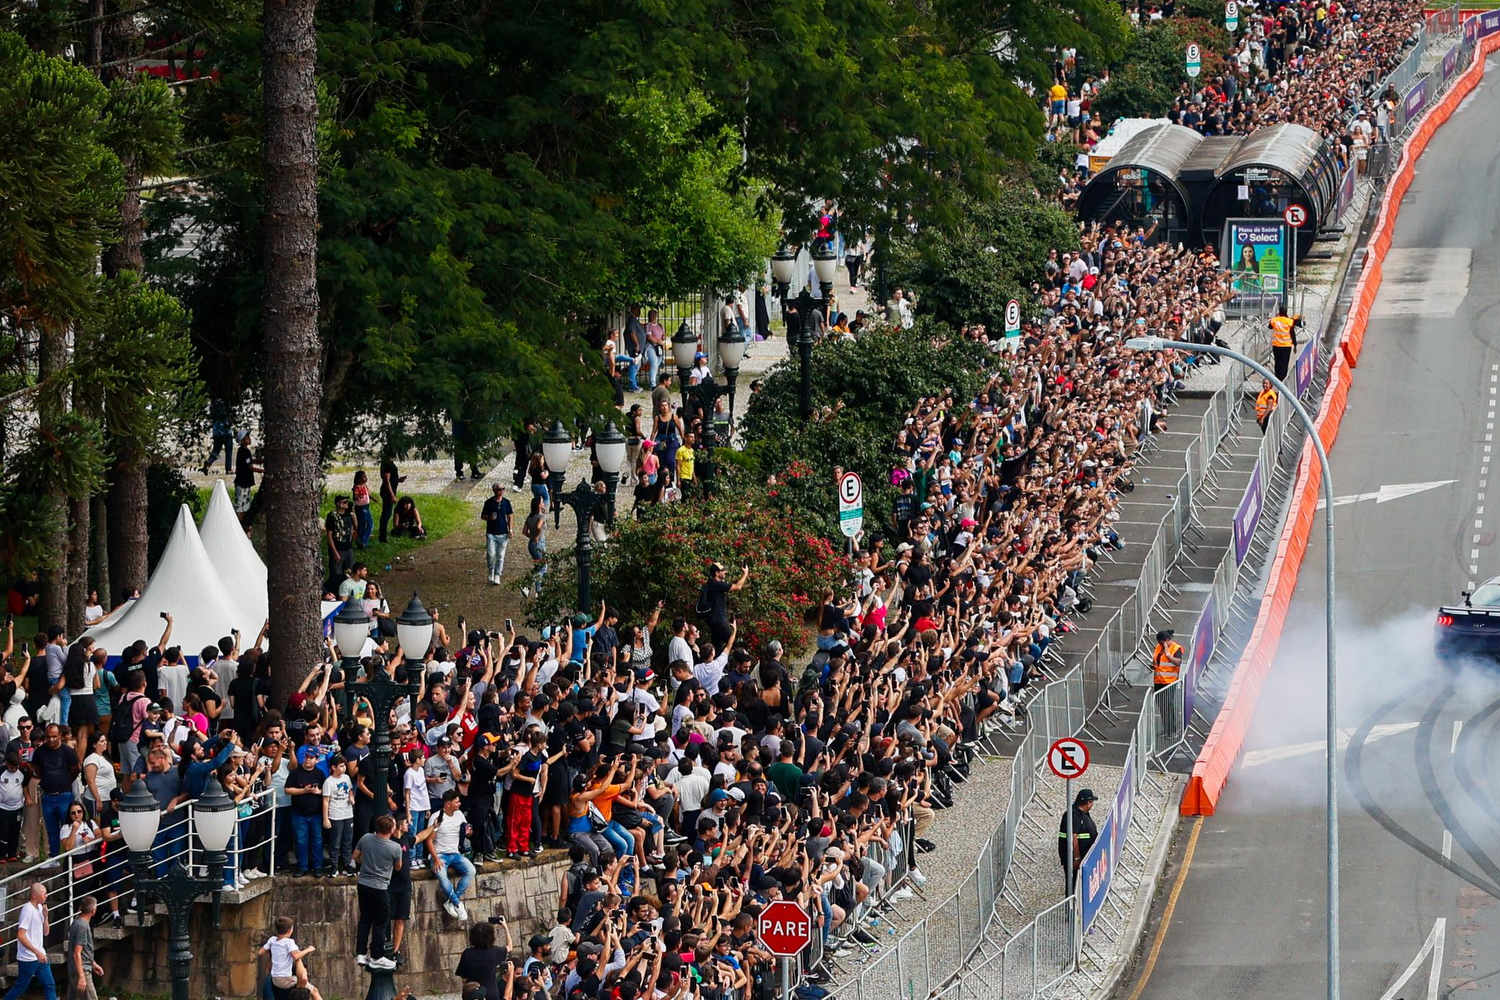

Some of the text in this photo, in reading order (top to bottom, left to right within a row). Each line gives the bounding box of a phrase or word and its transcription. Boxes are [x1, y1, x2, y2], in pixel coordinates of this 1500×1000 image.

[1291, 209, 1300, 222] E
[1249, 233, 1278, 242] Select
[1010, 306, 1015, 320] E
[847, 479, 854, 497] E
[1062, 747, 1076, 770] E
[762, 919, 807, 937] PARE
